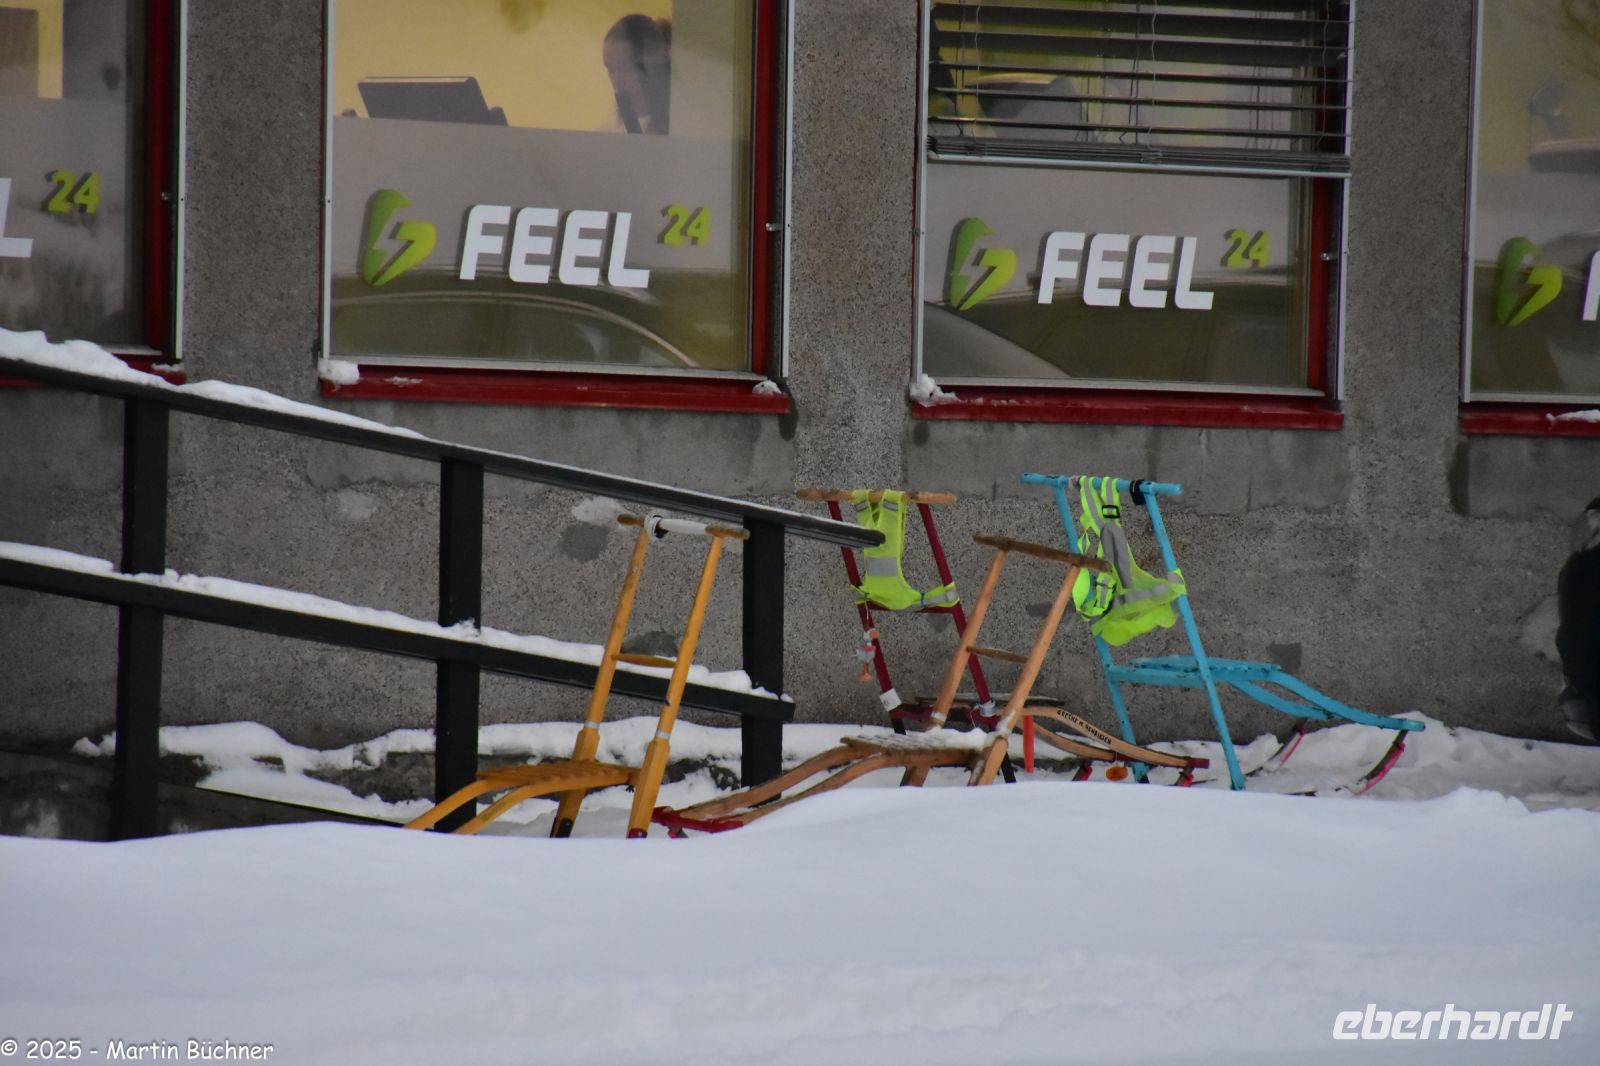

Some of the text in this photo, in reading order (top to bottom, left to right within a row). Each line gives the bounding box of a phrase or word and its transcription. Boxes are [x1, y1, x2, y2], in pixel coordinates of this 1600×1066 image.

[47, 168, 100, 215] 24
[459, 203, 711, 288] FEEL 24
[1038, 228, 1271, 310] FEEL 24
